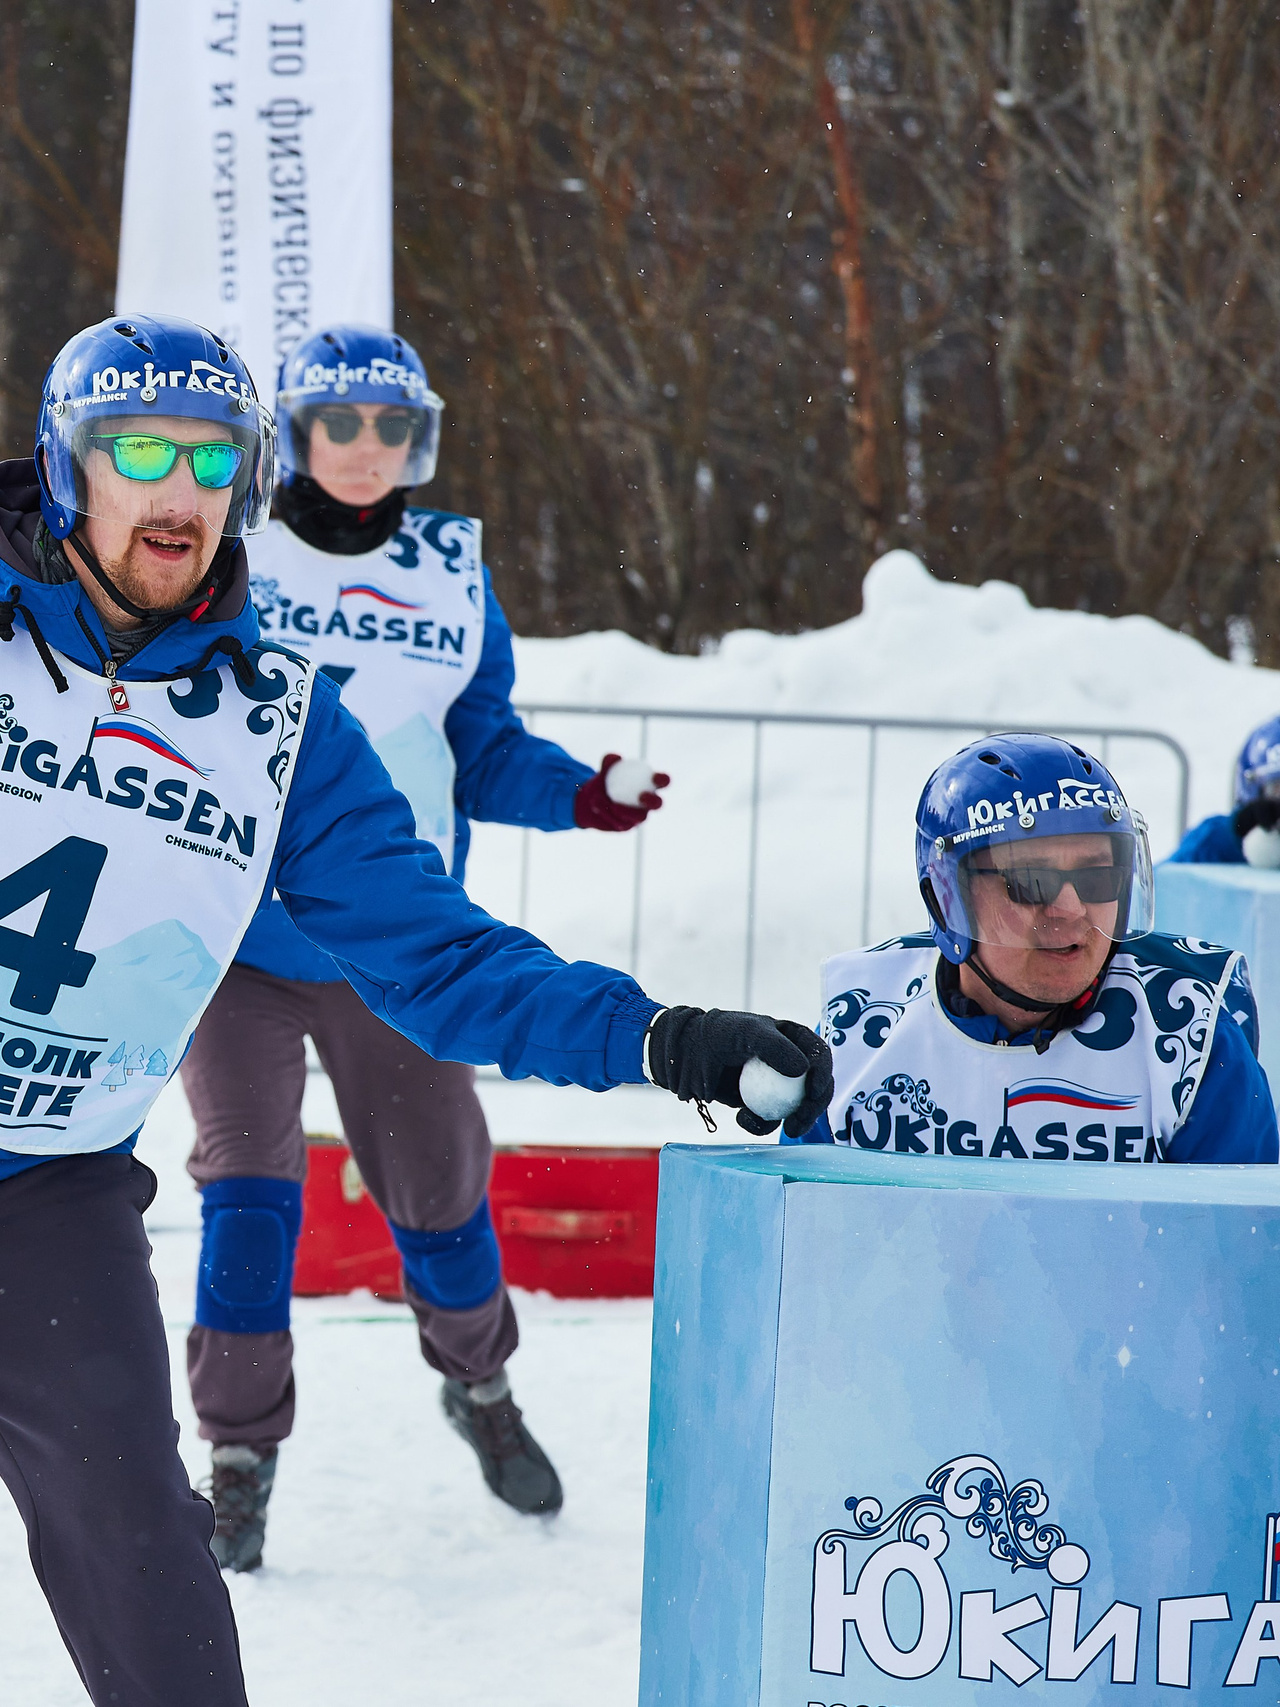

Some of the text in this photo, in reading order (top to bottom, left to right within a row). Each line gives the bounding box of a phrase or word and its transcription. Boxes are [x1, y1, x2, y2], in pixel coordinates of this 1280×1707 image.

[269, 24, 303, 76] по
[213, 81, 234, 106] и
[73, 392, 128, 409] МУРМАНСК
[953, 823, 1006, 845] МУРМАНСК
[165, 834, 248, 872] СНЕЖНЫЙ БОЙ
